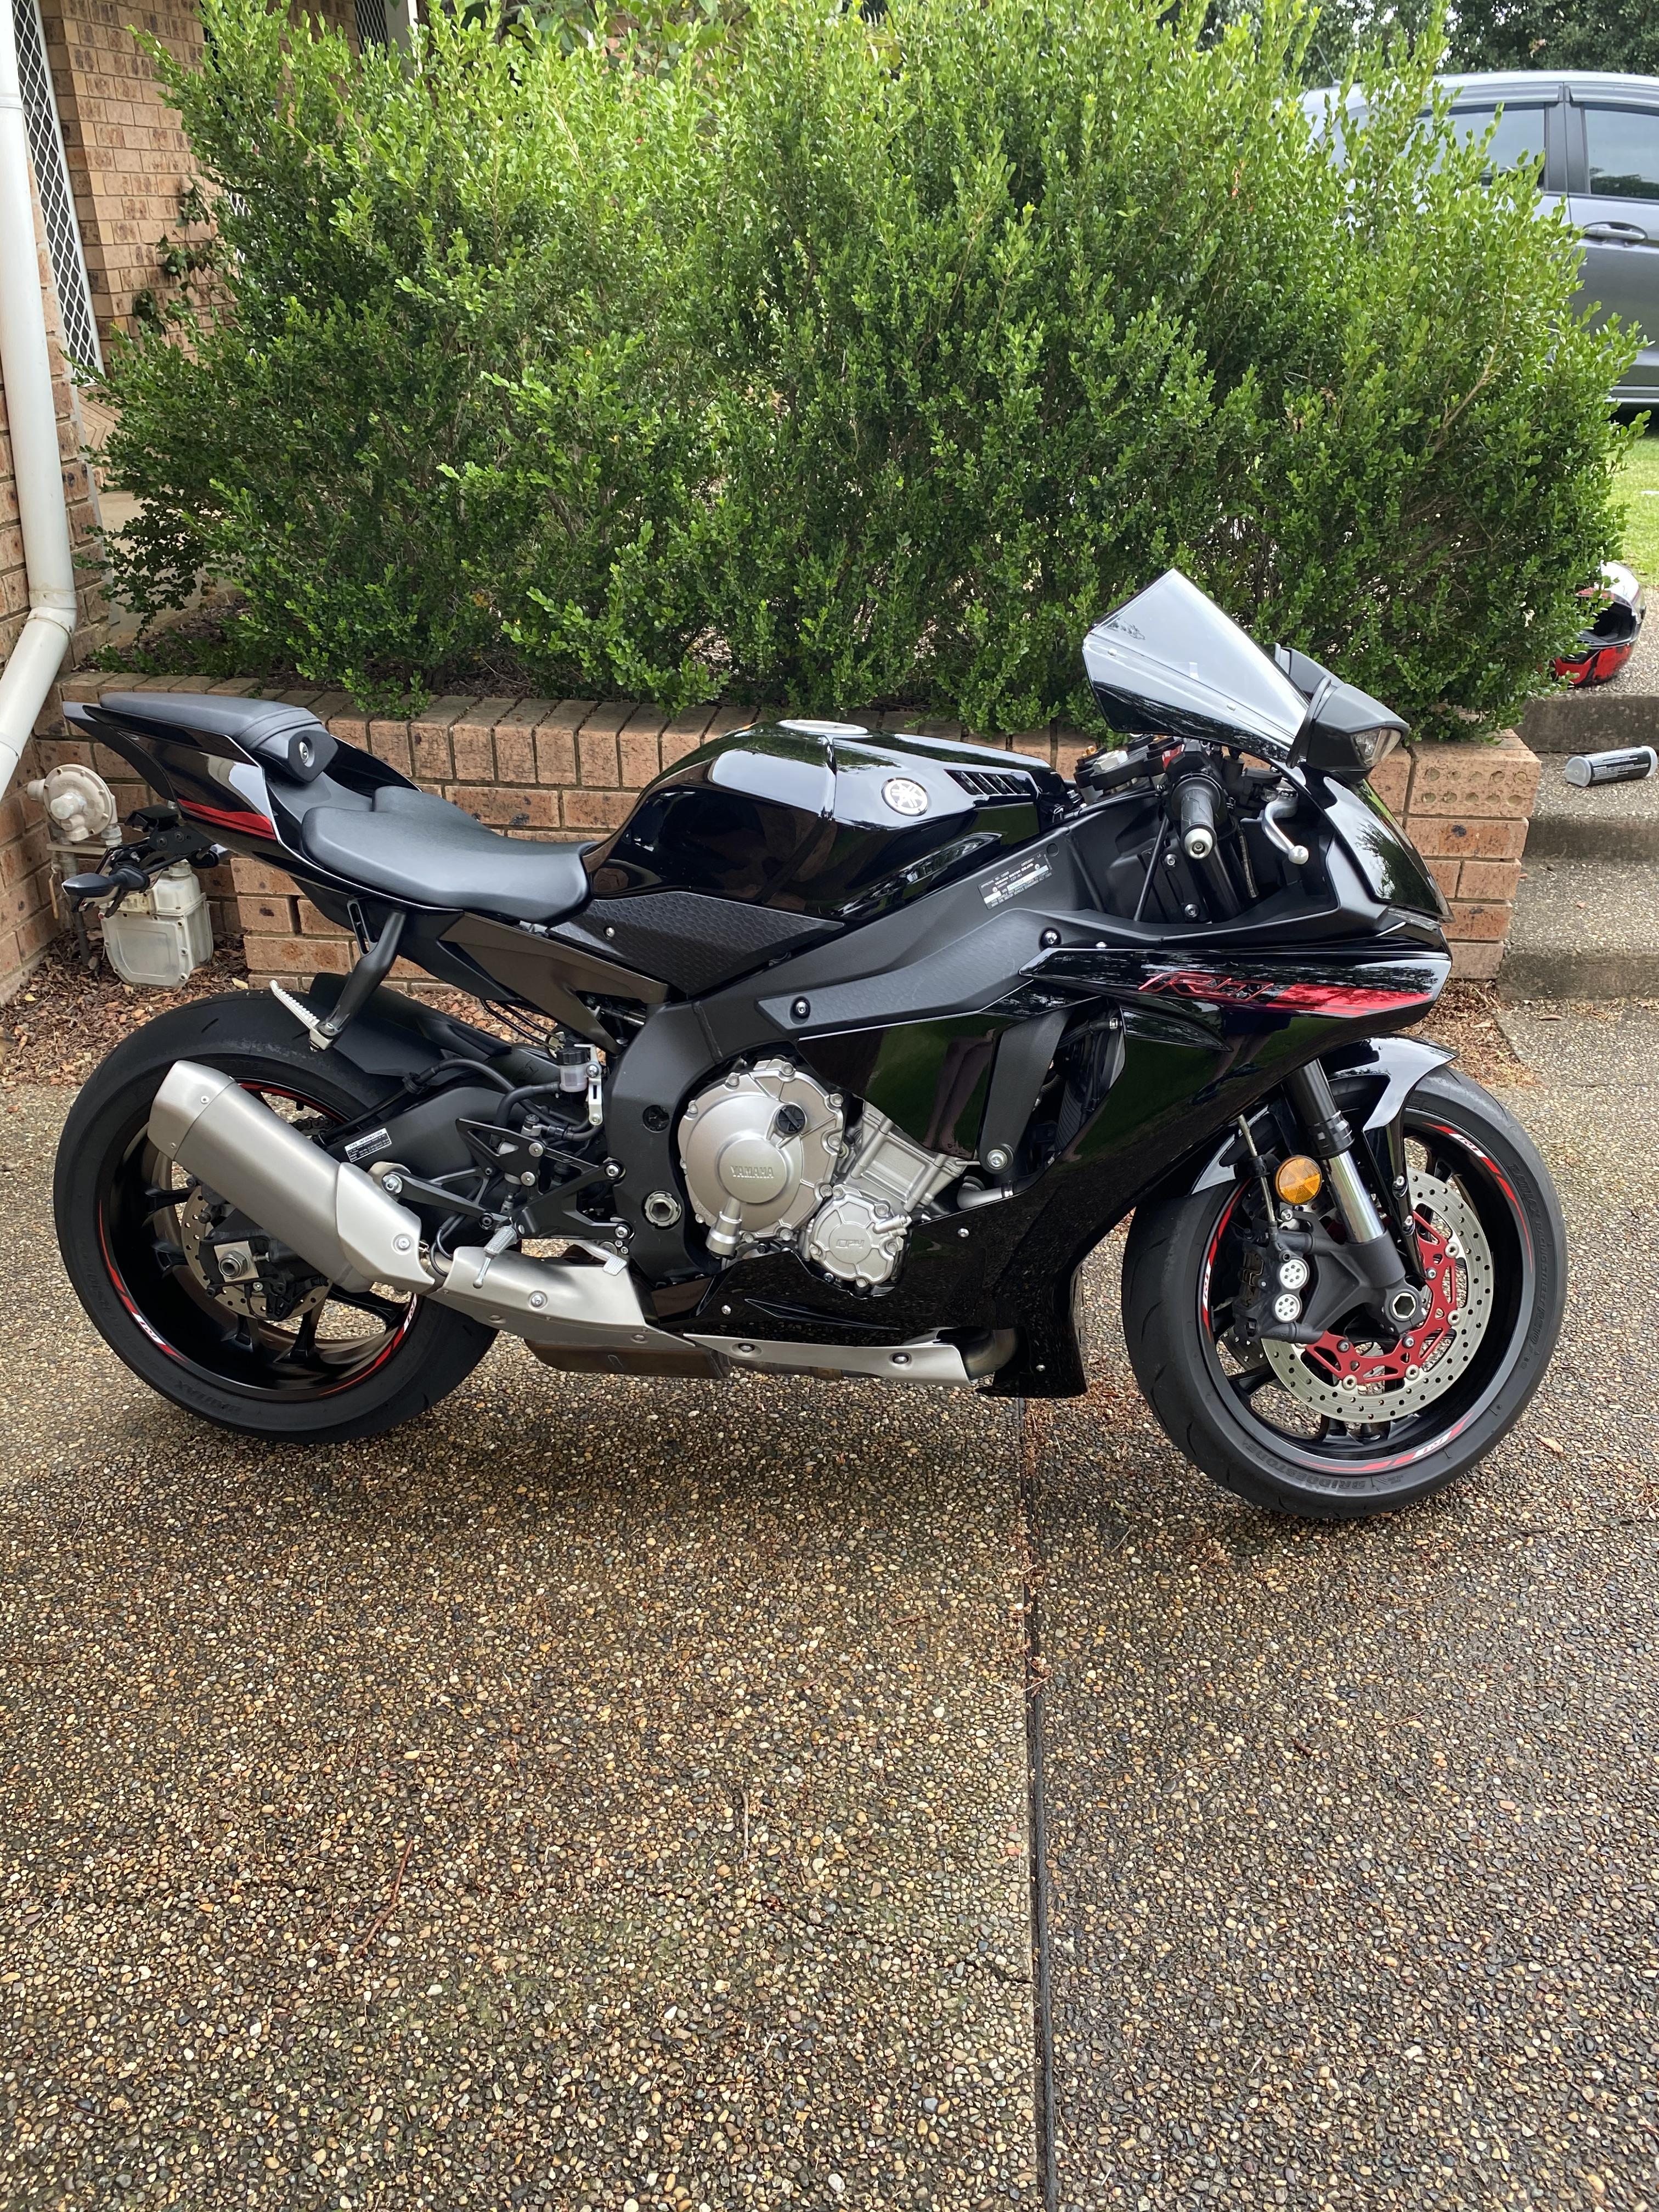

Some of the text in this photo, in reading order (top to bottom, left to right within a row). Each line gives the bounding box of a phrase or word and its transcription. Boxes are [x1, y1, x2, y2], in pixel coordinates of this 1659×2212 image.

[359, 1131, 383, 1144] INFORMATION
[730, 1165, 774, 1179] YAMAHA
[1243, 1442, 1366, 1490] BRIDGESTONE
